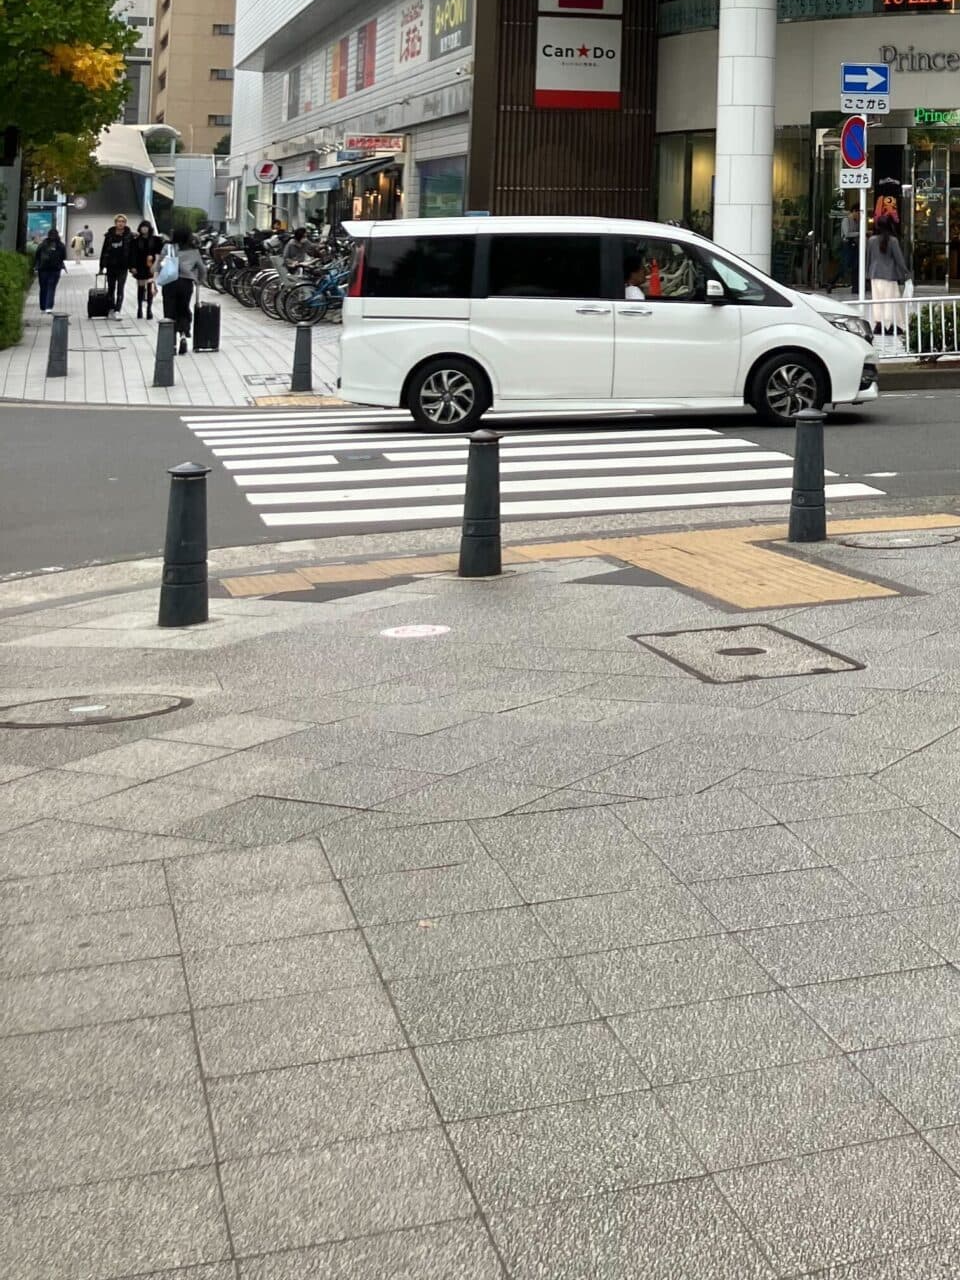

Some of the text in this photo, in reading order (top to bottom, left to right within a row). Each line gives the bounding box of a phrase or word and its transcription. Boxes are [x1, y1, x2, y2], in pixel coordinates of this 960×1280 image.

[879, 45, 960, 73] Prince
[844, 98, 887, 111] ここから
[841, 173, 869, 185] ここから
